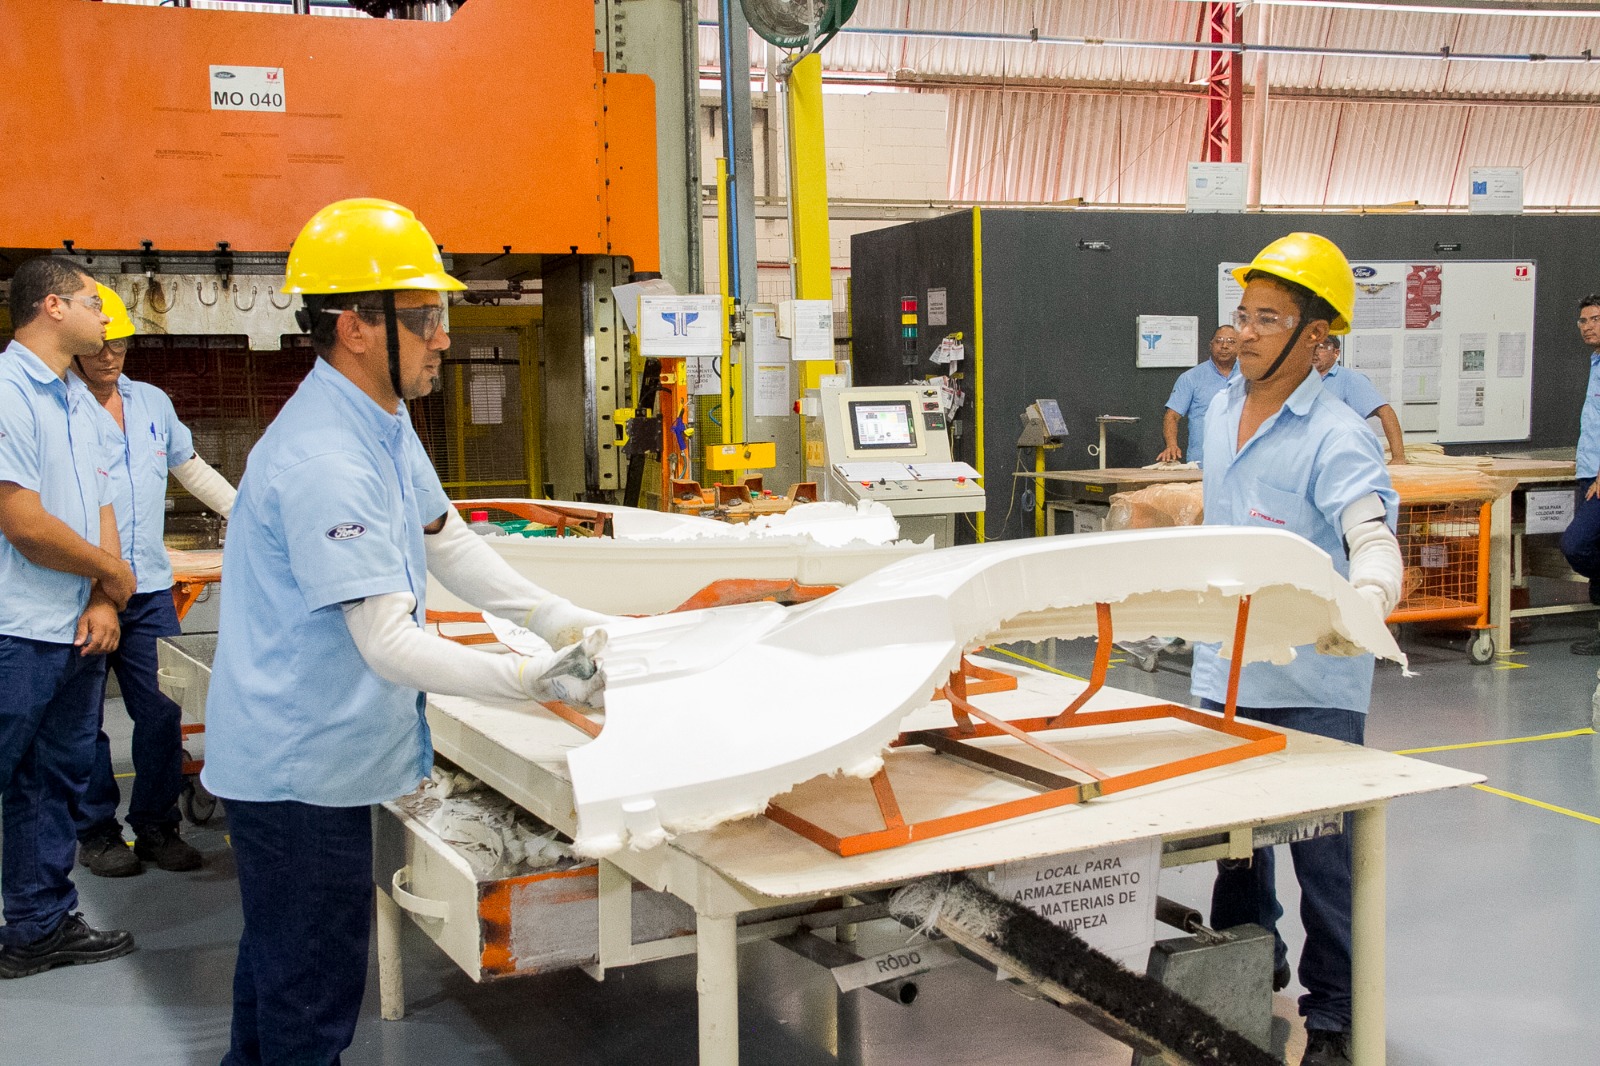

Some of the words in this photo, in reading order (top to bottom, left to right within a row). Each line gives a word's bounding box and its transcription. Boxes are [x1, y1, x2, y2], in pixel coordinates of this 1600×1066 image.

[214, 91, 244, 106] MO
[250, 92, 283, 107] 040
[1257, 512, 1286, 525] TROLLER
[1035, 864, 1080, 882] LOCAL
[1084, 857, 1122, 873] PARA
[1014, 871, 1140, 901] ARMAZENAMENTO
[1041, 893, 1115, 917] MATERIAIS
[1119, 890, 1137, 905] DE
[1058, 913, 1108, 933] IMPEZA
[875, 951, 921, 973] RÔDO
